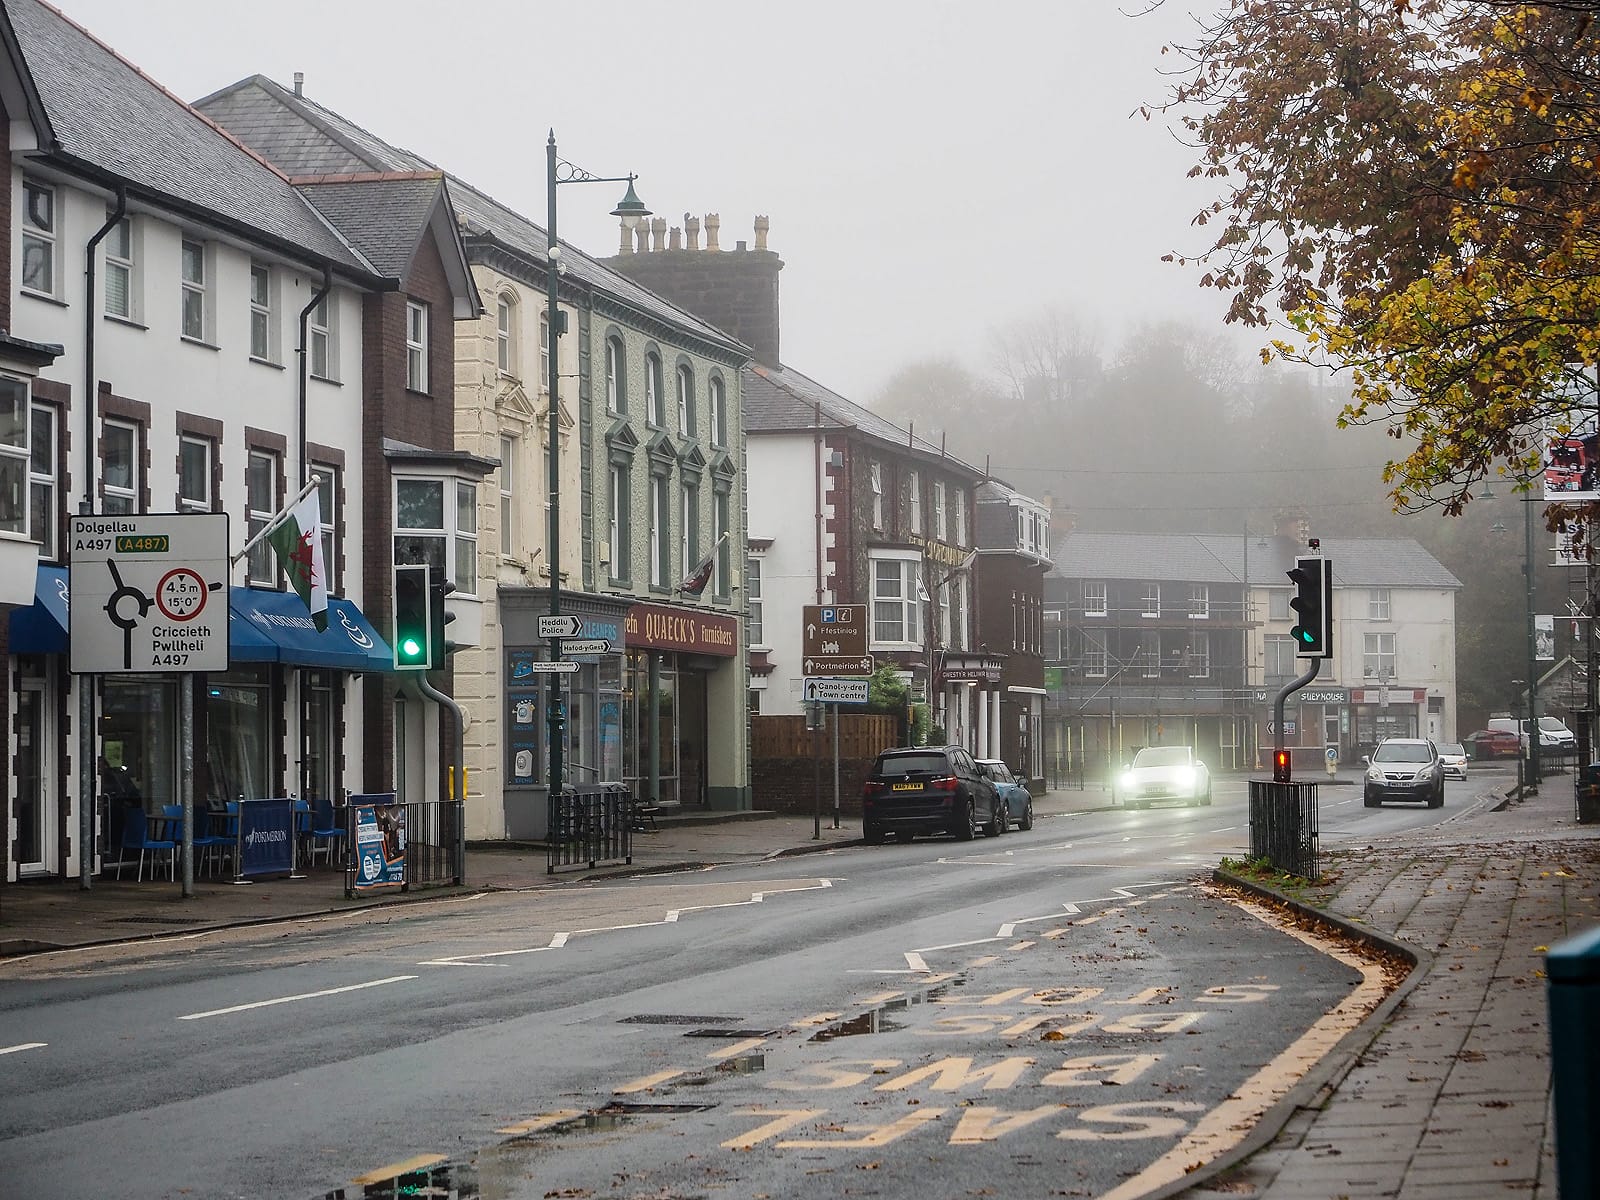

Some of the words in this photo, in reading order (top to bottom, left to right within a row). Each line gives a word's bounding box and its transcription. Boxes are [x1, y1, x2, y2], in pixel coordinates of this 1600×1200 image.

[76, 522, 136, 534] Dolgellau
[76, 539, 112, 551] A497
[117, 537, 167, 550] (A487)
[166, 582, 186, 593] 4.5
[823, 609, 833, 621] P
[152, 626, 211, 637] Criccieth
[584, 620, 617, 640] CLEANERS
[646, 613, 695, 643] QUAECK'S
[701, 624, 732, 645] Furnishers
[152, 640, 204, 651] Pwllheli
[152, 655, 189, 666] A497
[815, 662, 859, 670] Portmeirion
[818, 682, 866, 691] Canol-y-dref
[1300, 692, 1321, 701] SUEY
[1320, 692, 1345, 701] HOUSE
[913, 1011, 1209, 1036] BUS
[761, 1053, 1170, 1092] BWS
